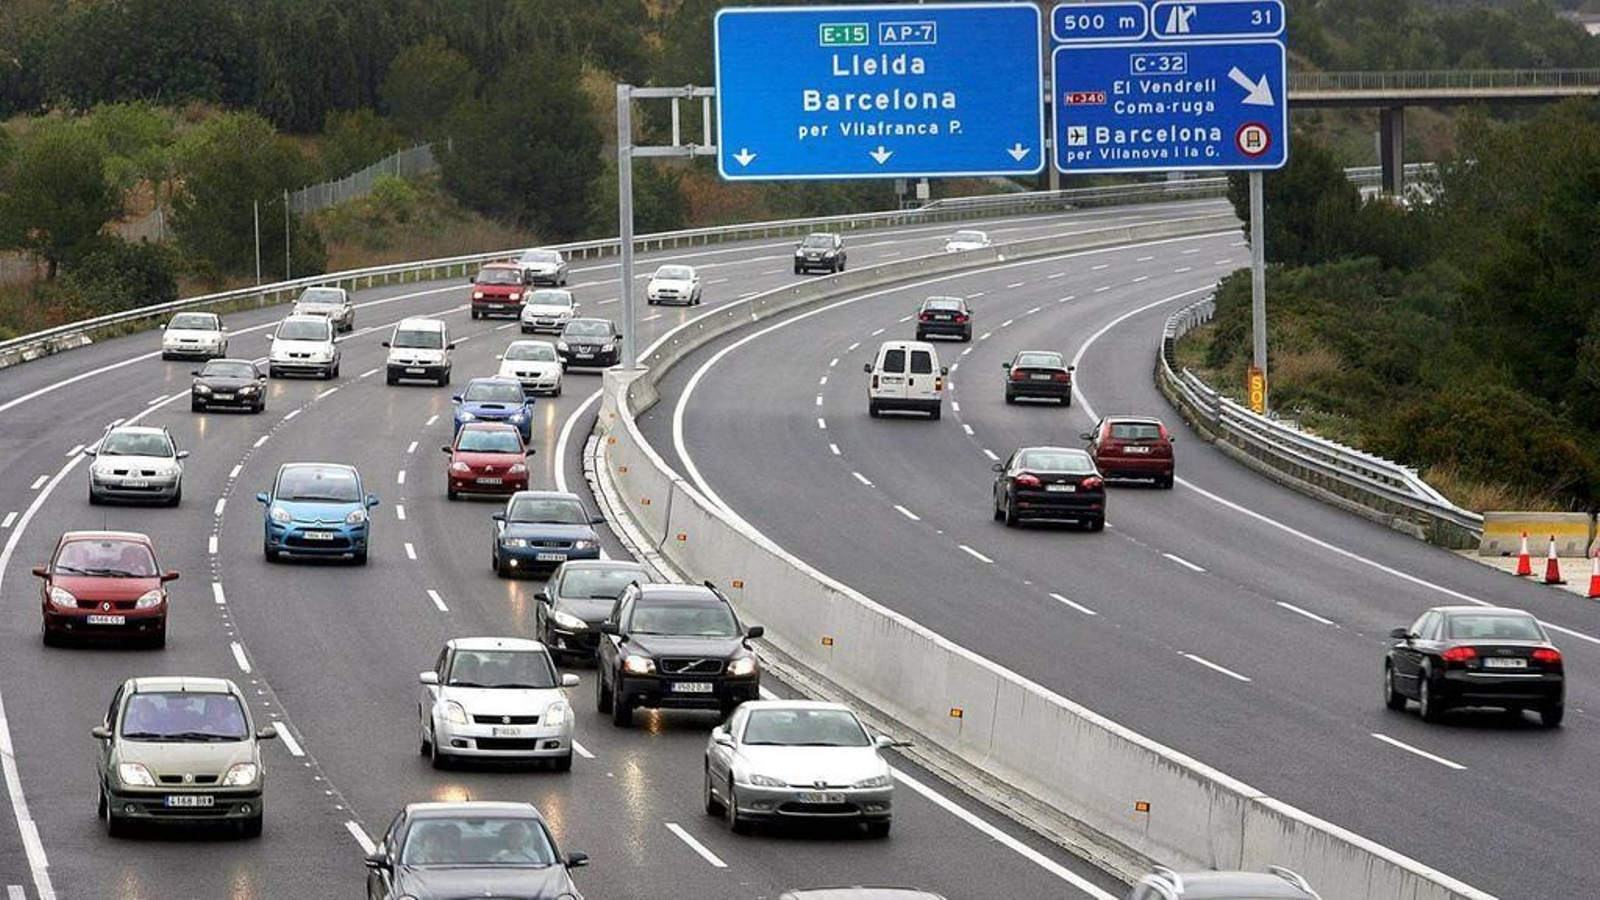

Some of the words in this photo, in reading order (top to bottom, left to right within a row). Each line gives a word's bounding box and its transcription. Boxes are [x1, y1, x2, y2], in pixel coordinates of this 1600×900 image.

[1064, 15, 1105, 29] 500
[1119, 17, 1135, 29] m
[1251, 10, 1272, 24] 31
[824, 28, 865, 42] E-15
[884, 26, 931, 41] AP-7
[833, 55, 925, 75] Lleida
[1134, 56, 1184, 72] C-32
[1113, 80, 1131, 94] El
[1140, 79, 1215, 93] Vendrell
[803, 88, 957, 111] Barcelona
[1066, 93, 1105, 104] N-340
[1114, 100, 1215, 116] Coma-ruga
[799, 124, 829, 139] per
[840, 122, 939, 136] Vilafranca
[949, 121, 964, 134] P.
[1095, 125, 1222, 144] Barcelona
[1067, 148, 1092, 163] per
[1099, 147, 1168, 160] Vilanova
[1184, 146, 1199, 158] la
[1205, 145, 1221, 157] G.
